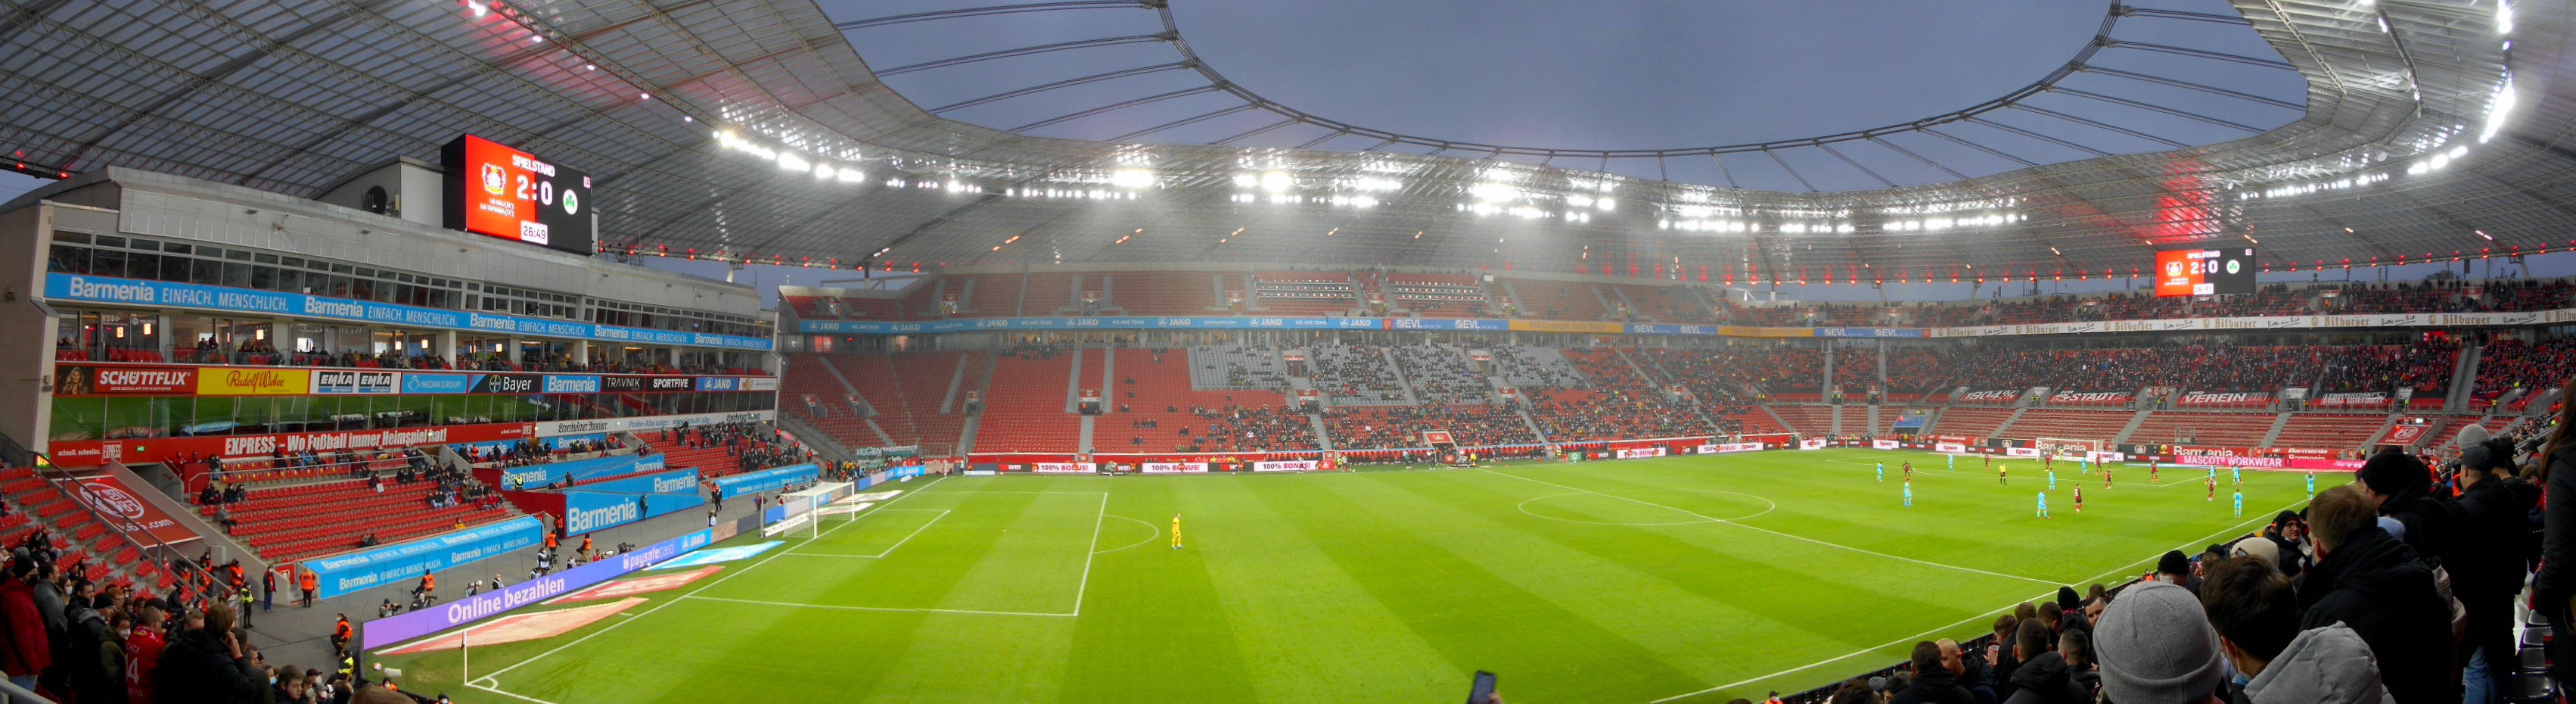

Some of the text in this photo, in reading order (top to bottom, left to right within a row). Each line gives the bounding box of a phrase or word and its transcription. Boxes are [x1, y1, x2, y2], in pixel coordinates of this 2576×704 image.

[512, 154, 555, 178] SPIELSTAND
[517, 174, 552, 206] 2:0
[523, 226, 546, 240] 26:49
[2190, 260, 2219, 275] 2:0
[70, 276, 289, 311] Barmenia EINFACH. MENSCHLICH.
[305, 296, 458, 326] Barmenia EINFACH. MENSCHLICH.
[470, 313, 586, 336] Barmenia EINFACH. MENSCHLICH.
[1405, 319, 1423, 329] EVL
[1463, 319, 1481, 329] EVL
[2214, 319, 2257, 329] Bitburger
[2324, 316, 2370, 327] Bitburger
[2443, 314, 2491, 325] Bitburger
[595, 325, 688, 343] Barmenia EINFACH. MENSCHLICH.
[1642, 325, 1655, 333] EVL
[1687, 326, 1701, 334] EVL
[1832, 329, 1847, 337] EVL
[1882, 329, 1897, 337] EVL
[2026, 325, 2060, 334] Bitburger
[695, 333, 722, 346] Barmenia
[100, 371, 187, 385] SCHÜTTFLIX
[226, 370, 284, 394] Rudolf Weber
[321, 373, 353, 386] EMKA
[360, 373, 390, 387] EMKA
[503, 376, 532, 393] Bayer
[548, 376, 595, 393] Barmenia
[607, 378, 641, 388] TRAVNIK
[653, 378, 689, 388] SPORTFIVE
[713, 379, 732, 389] JAKO
[2071, 392, 2118, 401] STADT
[2186, 393, 2248, 403] VEREIN
[225, 436, 276, 455] EXPRESS
[287, 435, 306, 451] Wo
[307, 432, 347, 450] Fußball
[349, 431, 381, 447] immer
[382, 429, 427, 447] Heimspiel
[635, 459, 663, 473] Barmenia
[2227, 456, 2282, 467] WORKWEAR
[503, 468, 547, 486] Bamenia
[654, 472, 696, 493] Barmenia
[568, 497, 637, 533] Barmenia
[441, 531, 479, 545] Barmenia
[690, 533, 706, 545] JAKO
[452, 537, 530, 563] Barmenia EINFACH. MENSCHLICH.
[629, 540, 674, 570] paysafecard
[320, 555, 369, 569] Barmenia
[339, 559, 441, 590] Barmenia EINFACH. MENSCHLICH.
[448, 576, 564, 624] Online bezahlen
